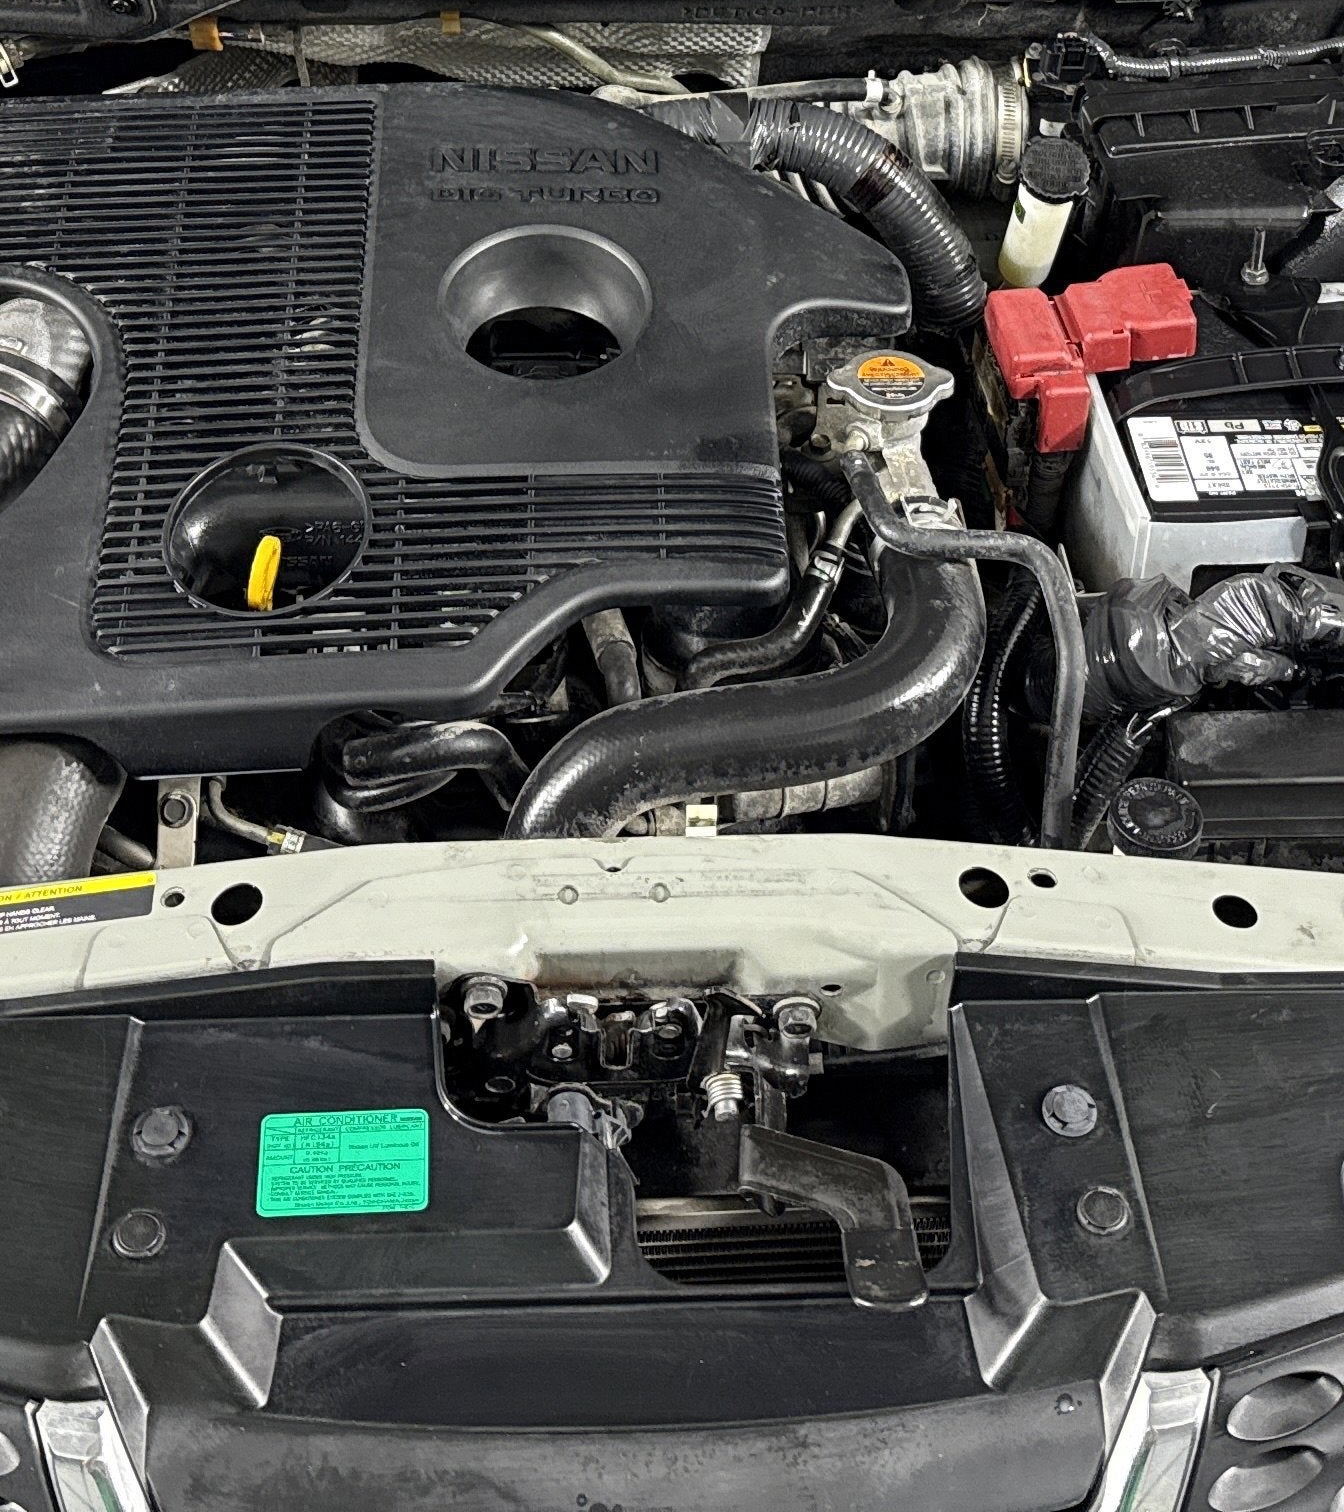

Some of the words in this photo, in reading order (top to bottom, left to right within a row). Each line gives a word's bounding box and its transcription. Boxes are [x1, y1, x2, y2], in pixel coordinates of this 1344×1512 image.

[431, 147, 658, 174] NISSAN
[430, 187, 502, 203] DIG
[508, 187, 660, 203] TURBO
[1224, 421, 1245, 430] Pb
[23, 885, 83, 900] ATTENTION
[294, 1117, 313, 1126] AIR
[318, 1113, 398, 1126] CONDITIONER
[289, 1165, 334, 1174] CAUTION
